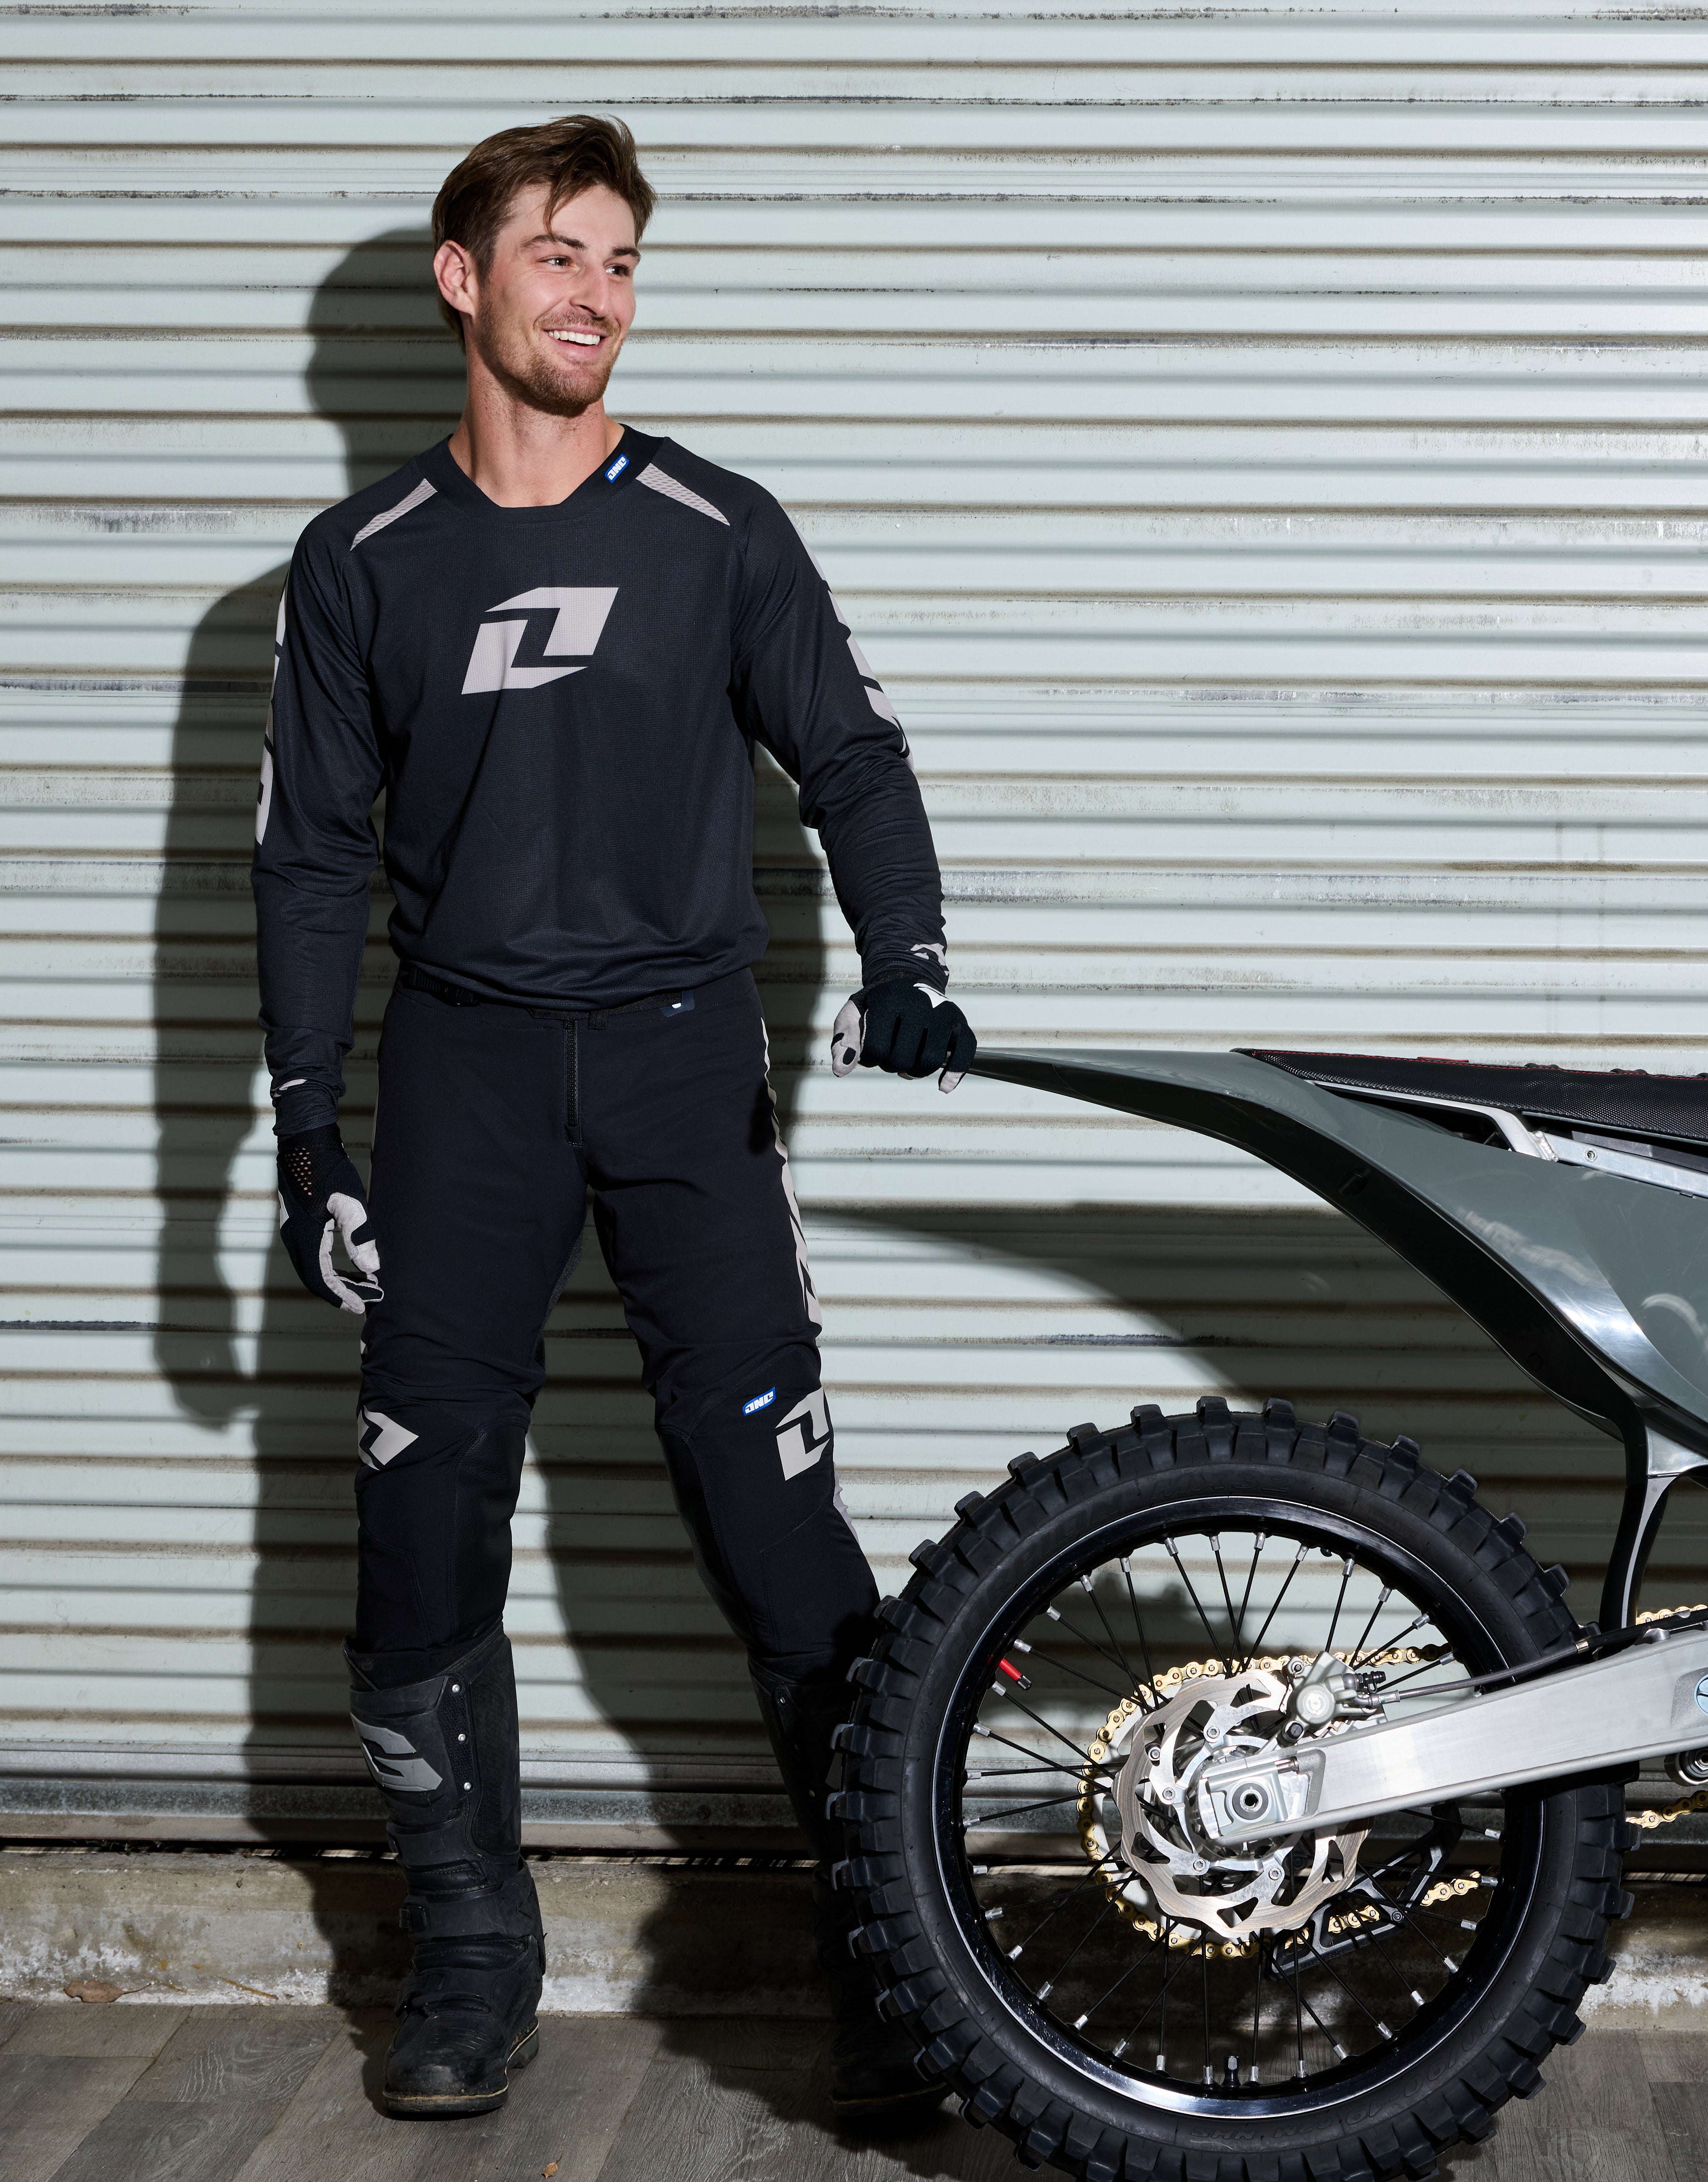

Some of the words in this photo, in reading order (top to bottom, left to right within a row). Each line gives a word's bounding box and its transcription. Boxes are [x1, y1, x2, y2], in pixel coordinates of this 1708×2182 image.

[925, 1495, 1128, 1705] SCORPION
[1148, 1472, 1296, 1501] MX32
[1503, 1629, 1529, 1665] SO
[1345, 2002, 1505, 2124] 110/90-19
[1191, 2127, 1256, 2139] NHS
